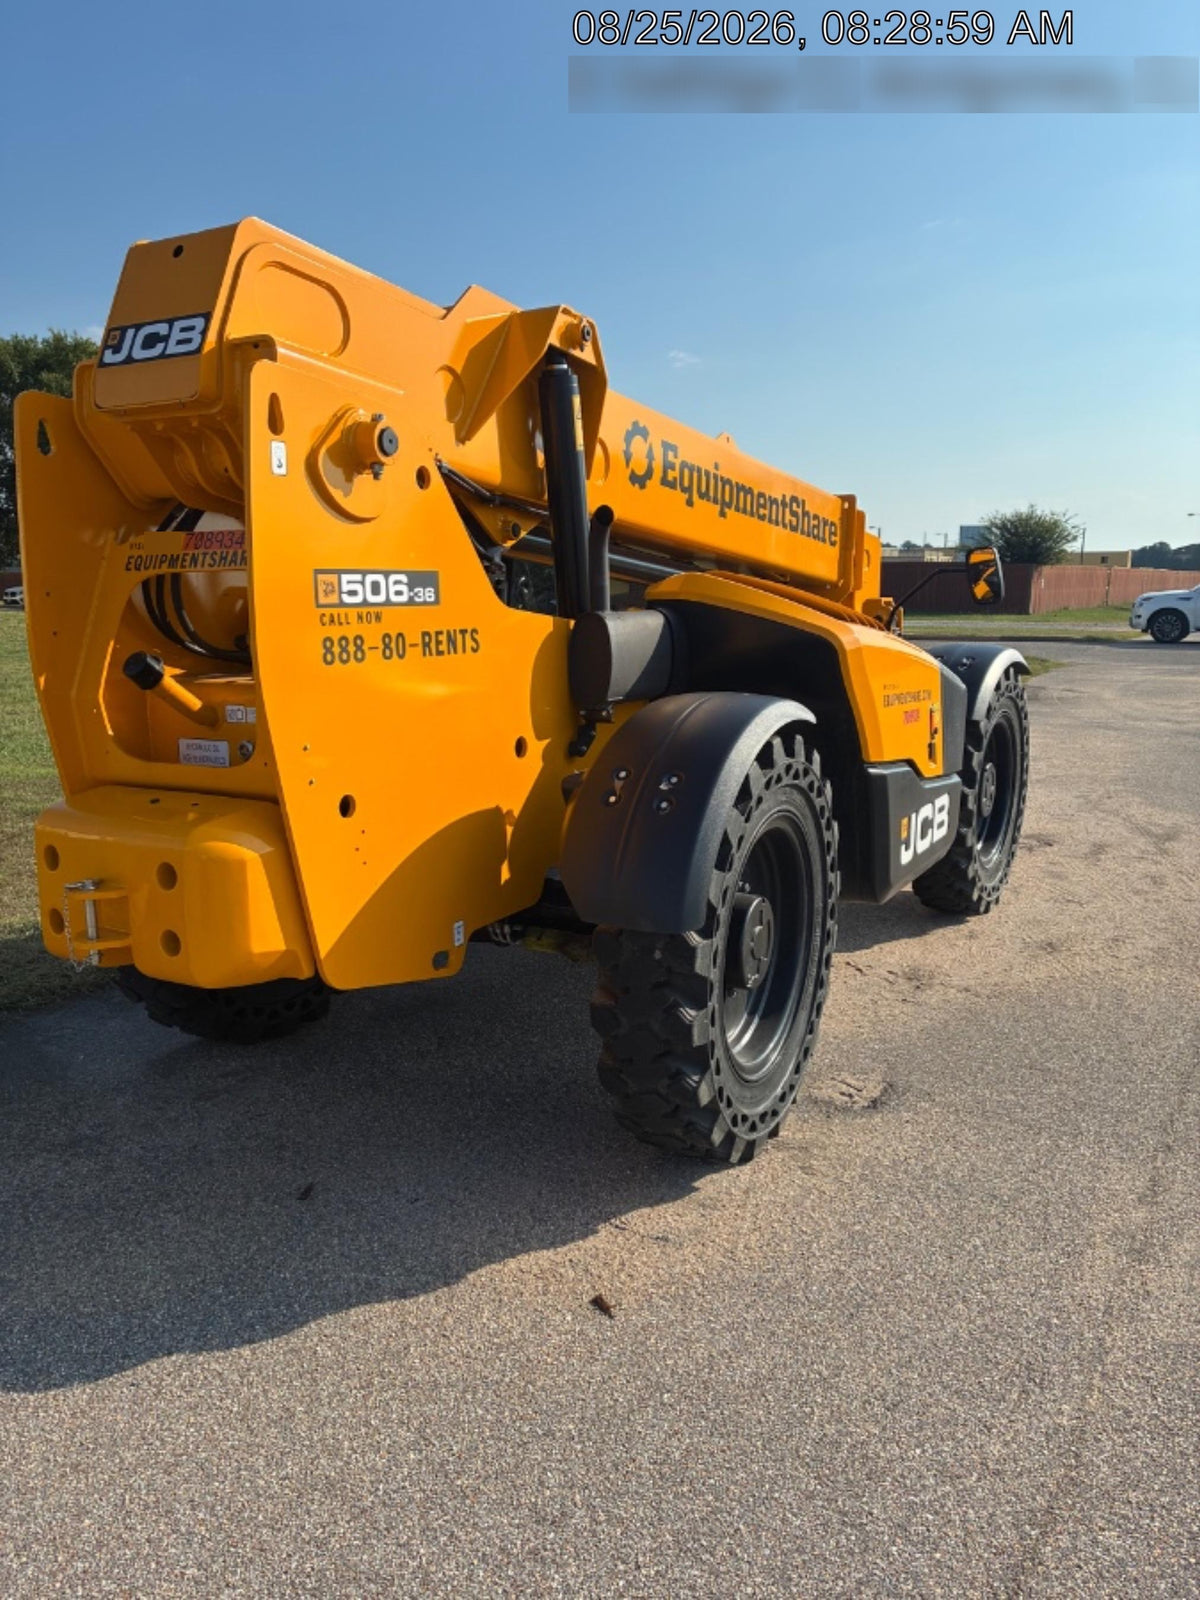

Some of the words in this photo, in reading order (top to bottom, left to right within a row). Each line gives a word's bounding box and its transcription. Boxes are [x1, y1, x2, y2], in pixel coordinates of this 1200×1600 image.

[102, 316, 206, 364] JCB
[660, 439, 838, 548] EquipmentShare
[319, 612, 351, 626] CALL
[356, 611, 383, 625] NOW
[322, 628, 481, 666] 888-80-RENTS
[900, 792, 950, 866] JCB
